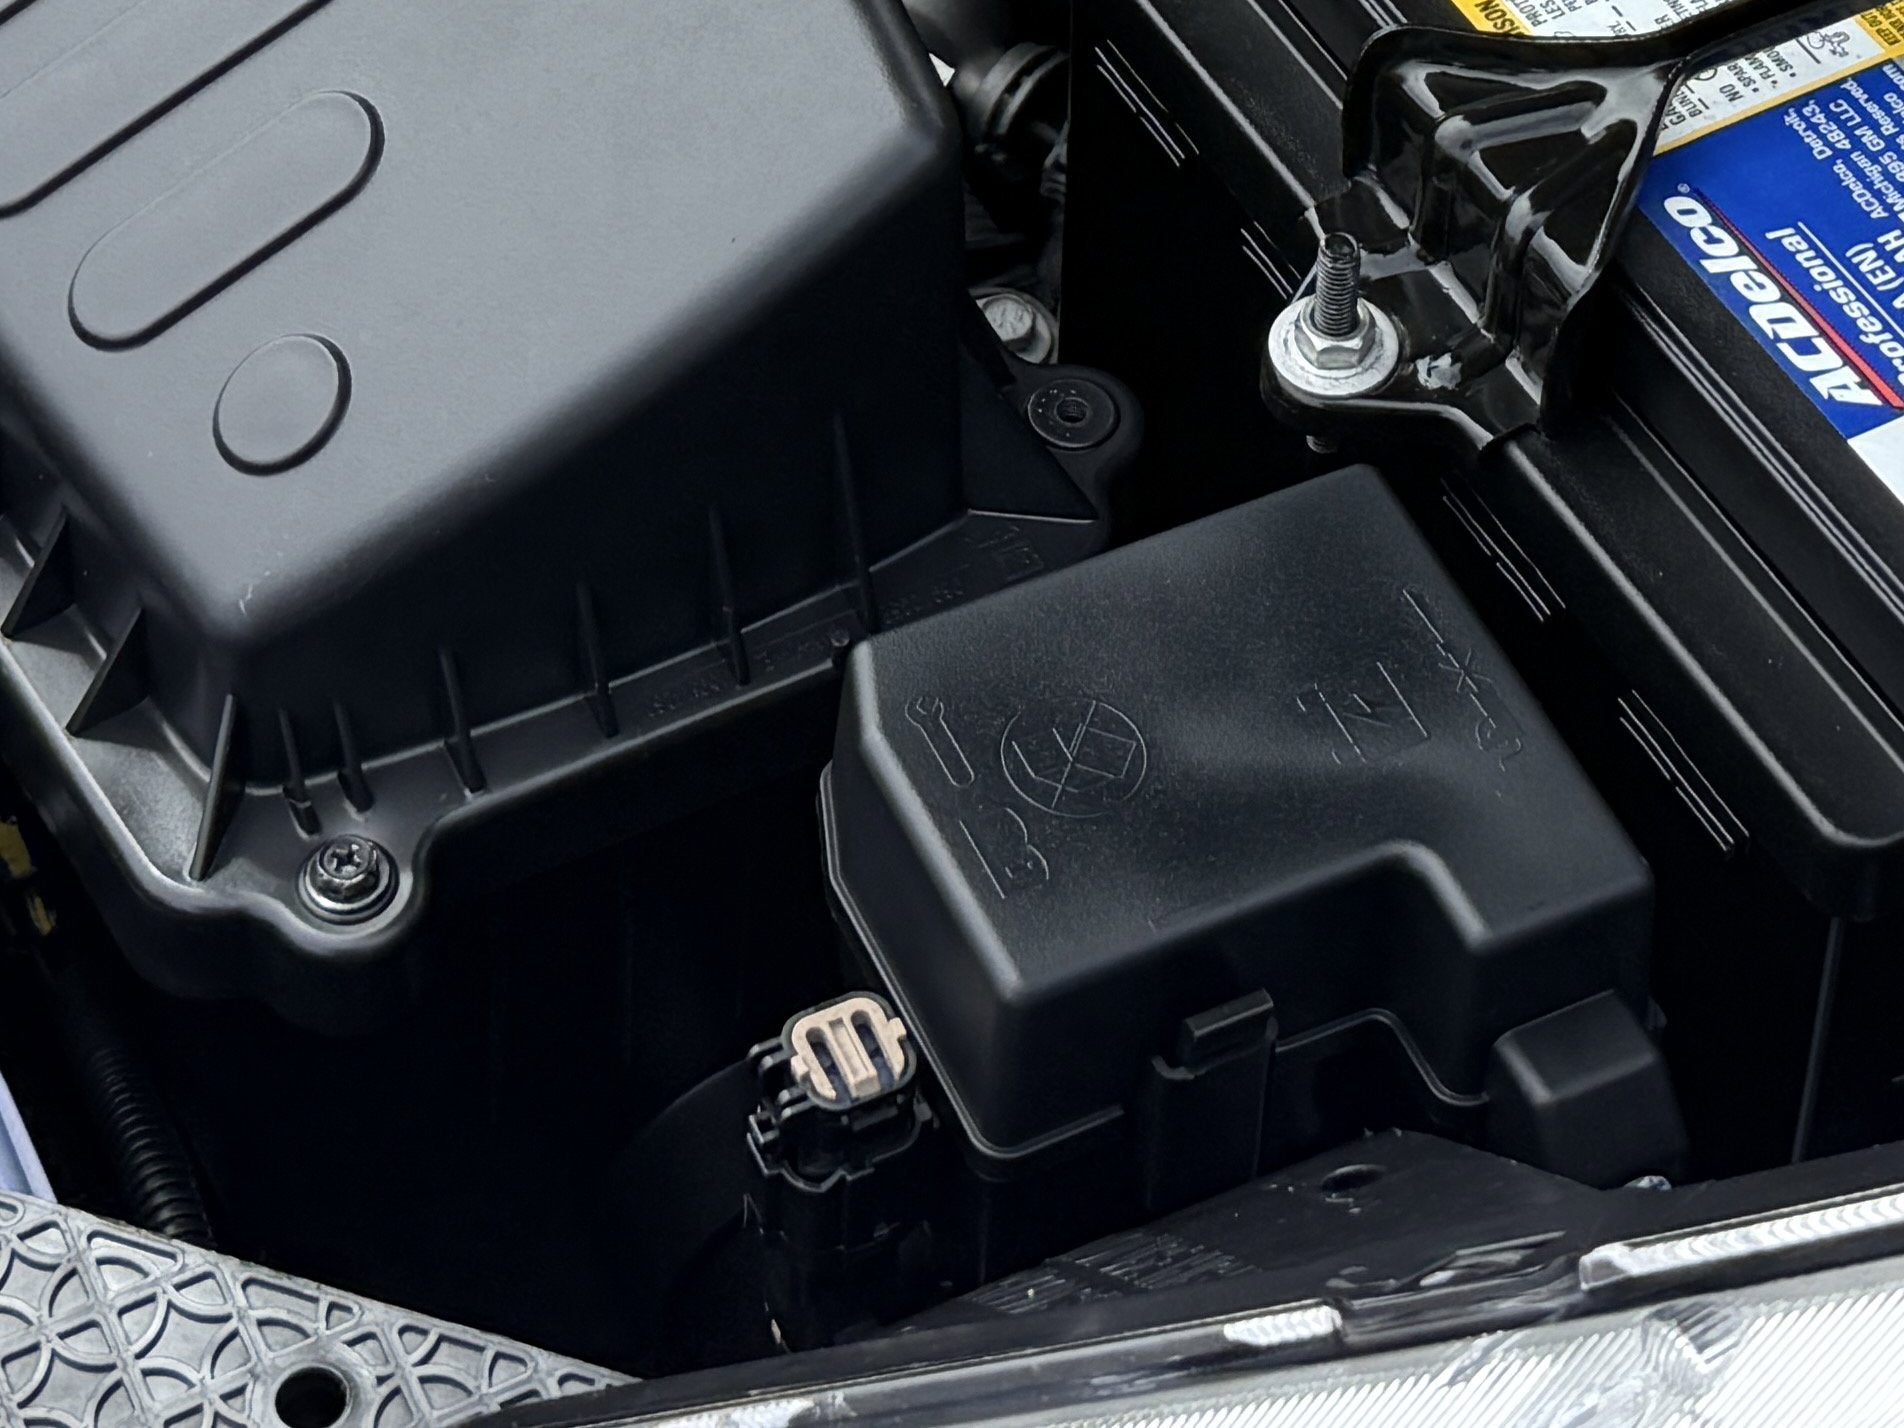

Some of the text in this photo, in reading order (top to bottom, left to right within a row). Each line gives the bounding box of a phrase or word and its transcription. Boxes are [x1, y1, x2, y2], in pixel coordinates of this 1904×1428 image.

[1725, 61, 1757, 87] SPAR
[1716, 82, 1743, 102] NO
[1836, 76, 1900, 135] Reserved.
[1797, 98, 1856, 152] 48243,
[1826, 97, 1863, 126] LLC
[1776, 107, 1834, 160] Detroit,
[1853, 125, 1887, 152] GM
